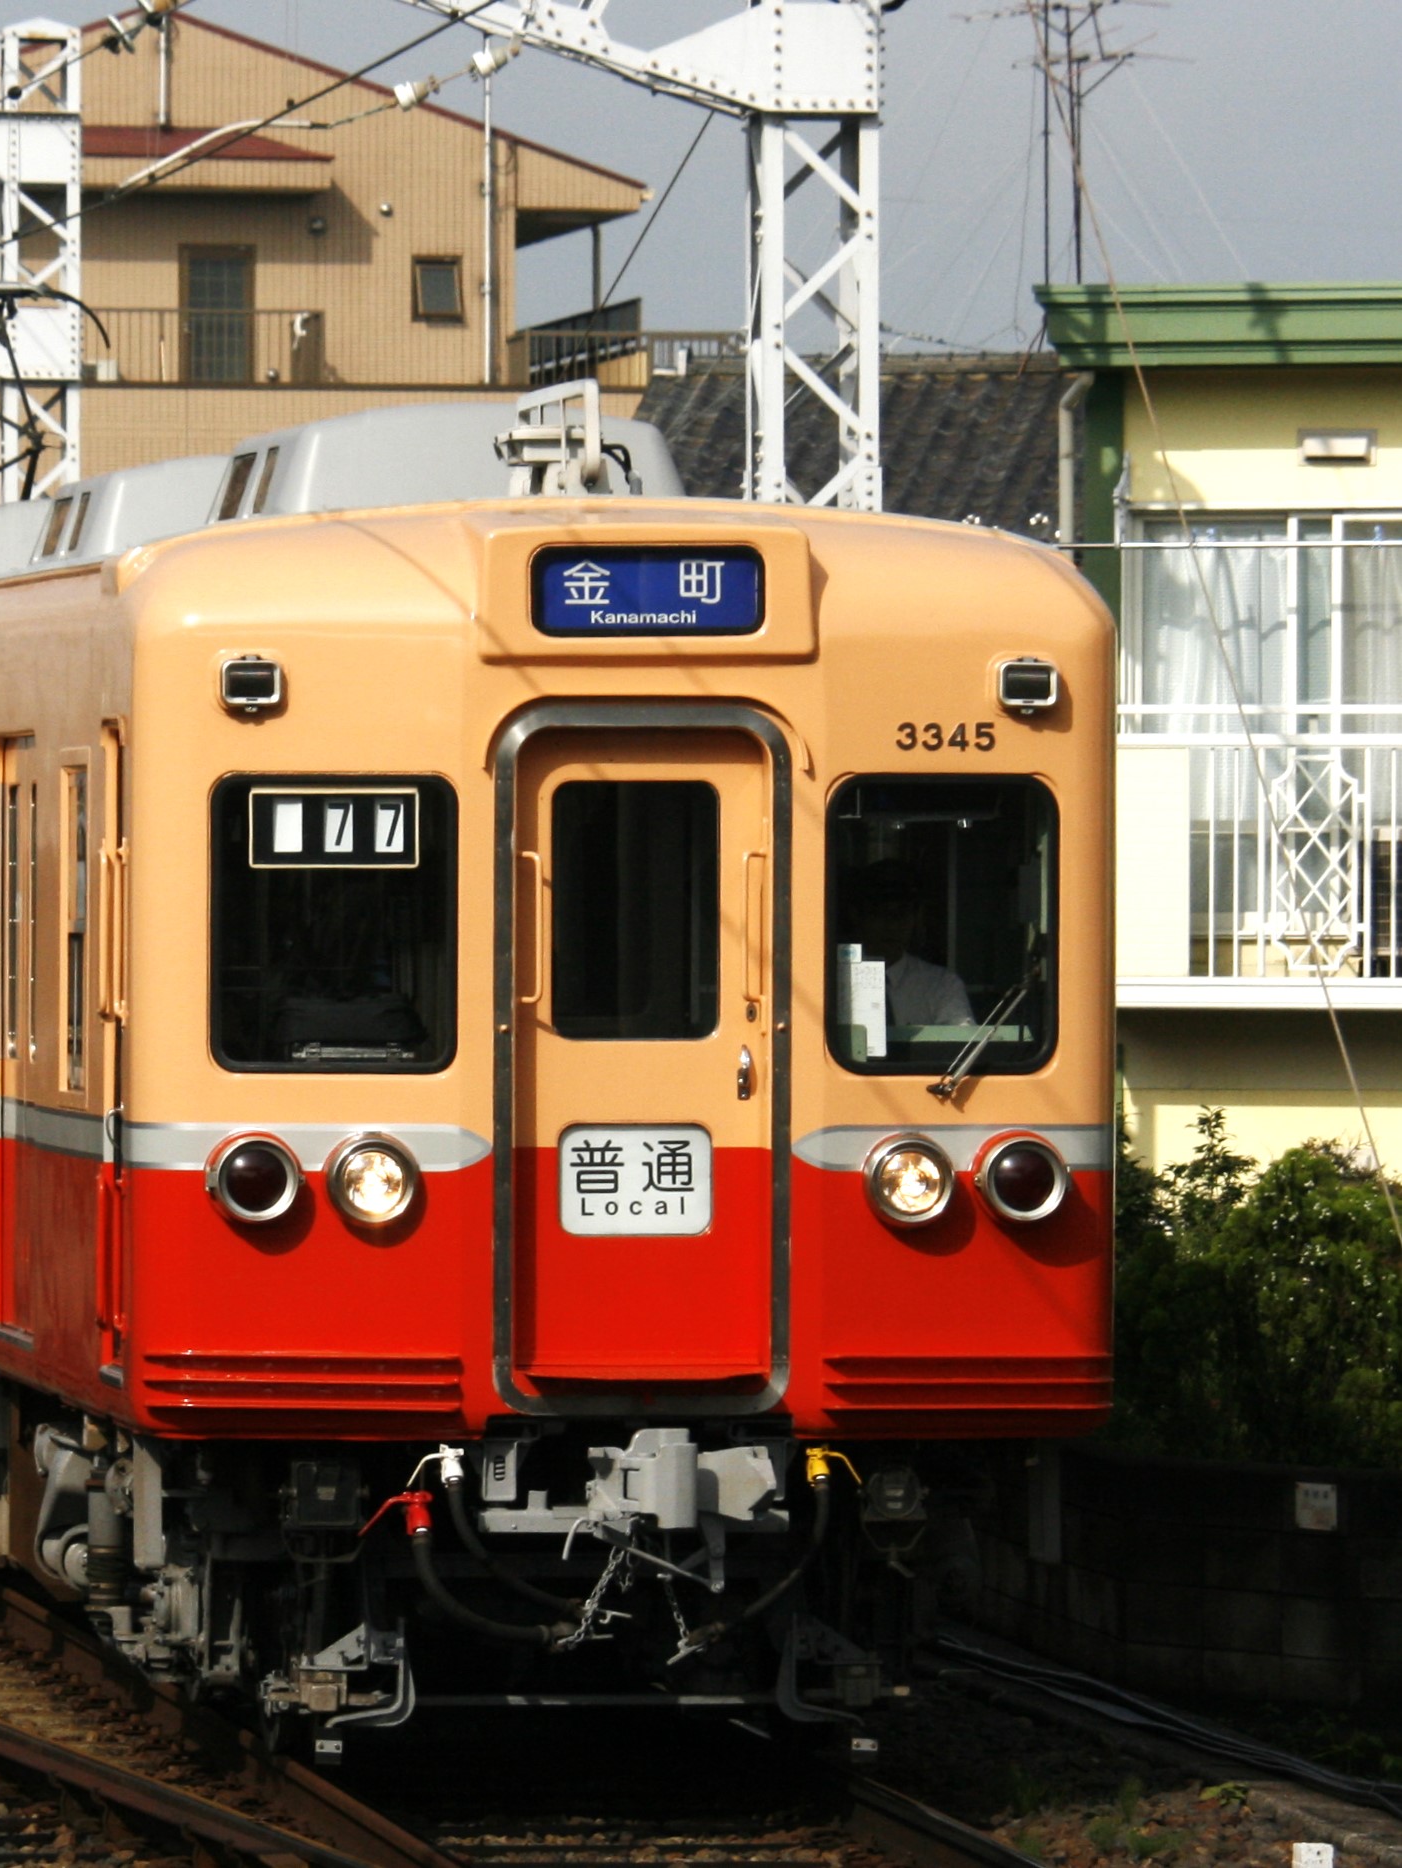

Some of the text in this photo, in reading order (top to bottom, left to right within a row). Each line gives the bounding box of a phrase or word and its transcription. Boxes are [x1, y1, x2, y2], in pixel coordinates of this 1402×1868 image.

[562, 559, 725, 605] 金町
[590, 609, 697, 625] Kanamachi
[895, 721, 997, 752] 3345
[327, 802, 403, 847] 77
[569, 1139, 695, 1194] 普通
[580, 1196, 685, 1216] Local
